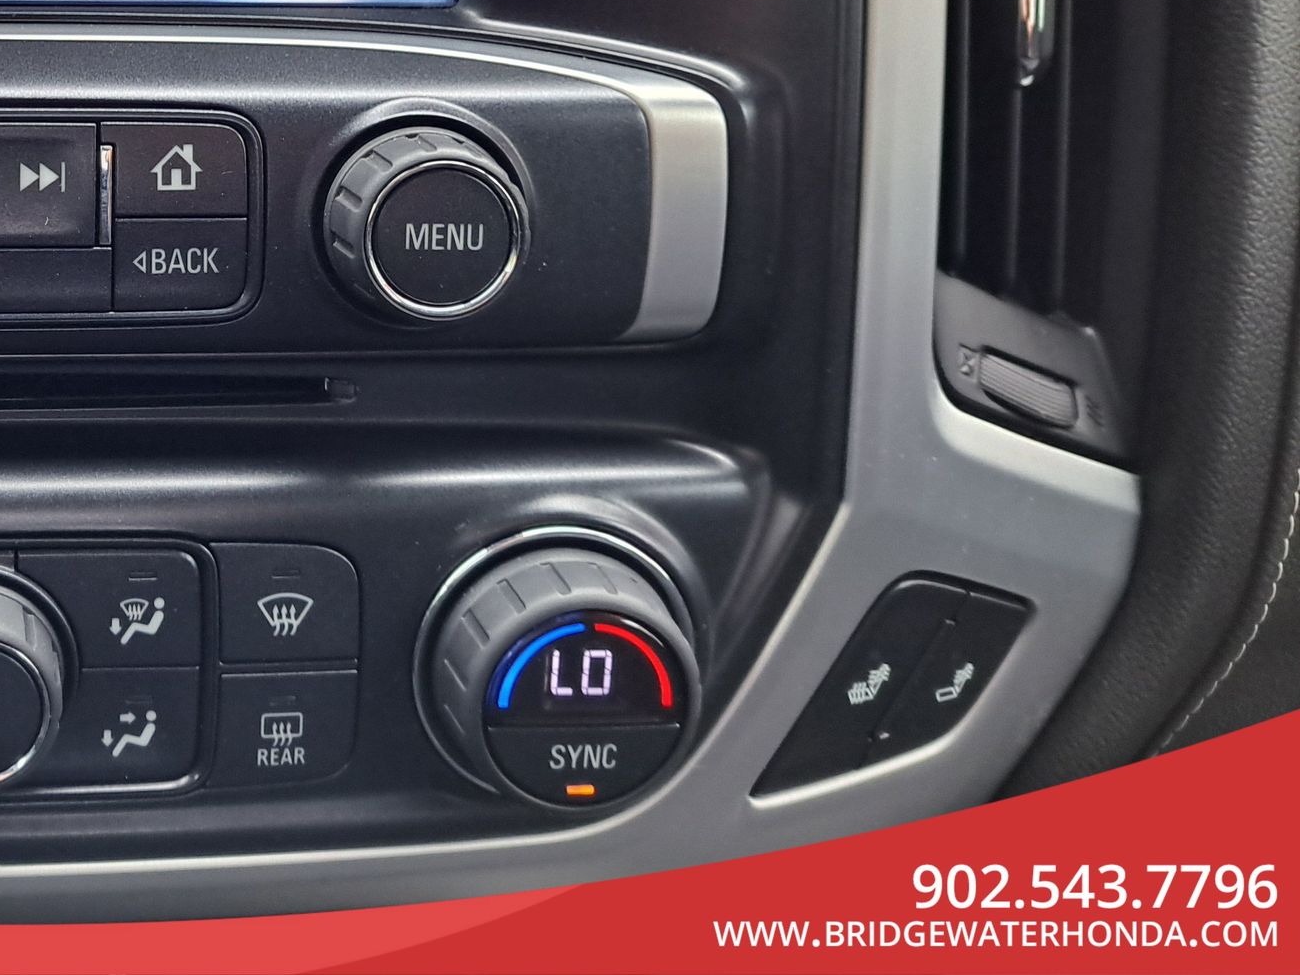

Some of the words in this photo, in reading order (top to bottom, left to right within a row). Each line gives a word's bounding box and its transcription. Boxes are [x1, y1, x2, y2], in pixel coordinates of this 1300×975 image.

[406, 224, 483, 250] MENU
[152, 248, 218, 274] BACK
[258, 747, 304, 765] REAR
[550, 744, 617, 769] SYNC
